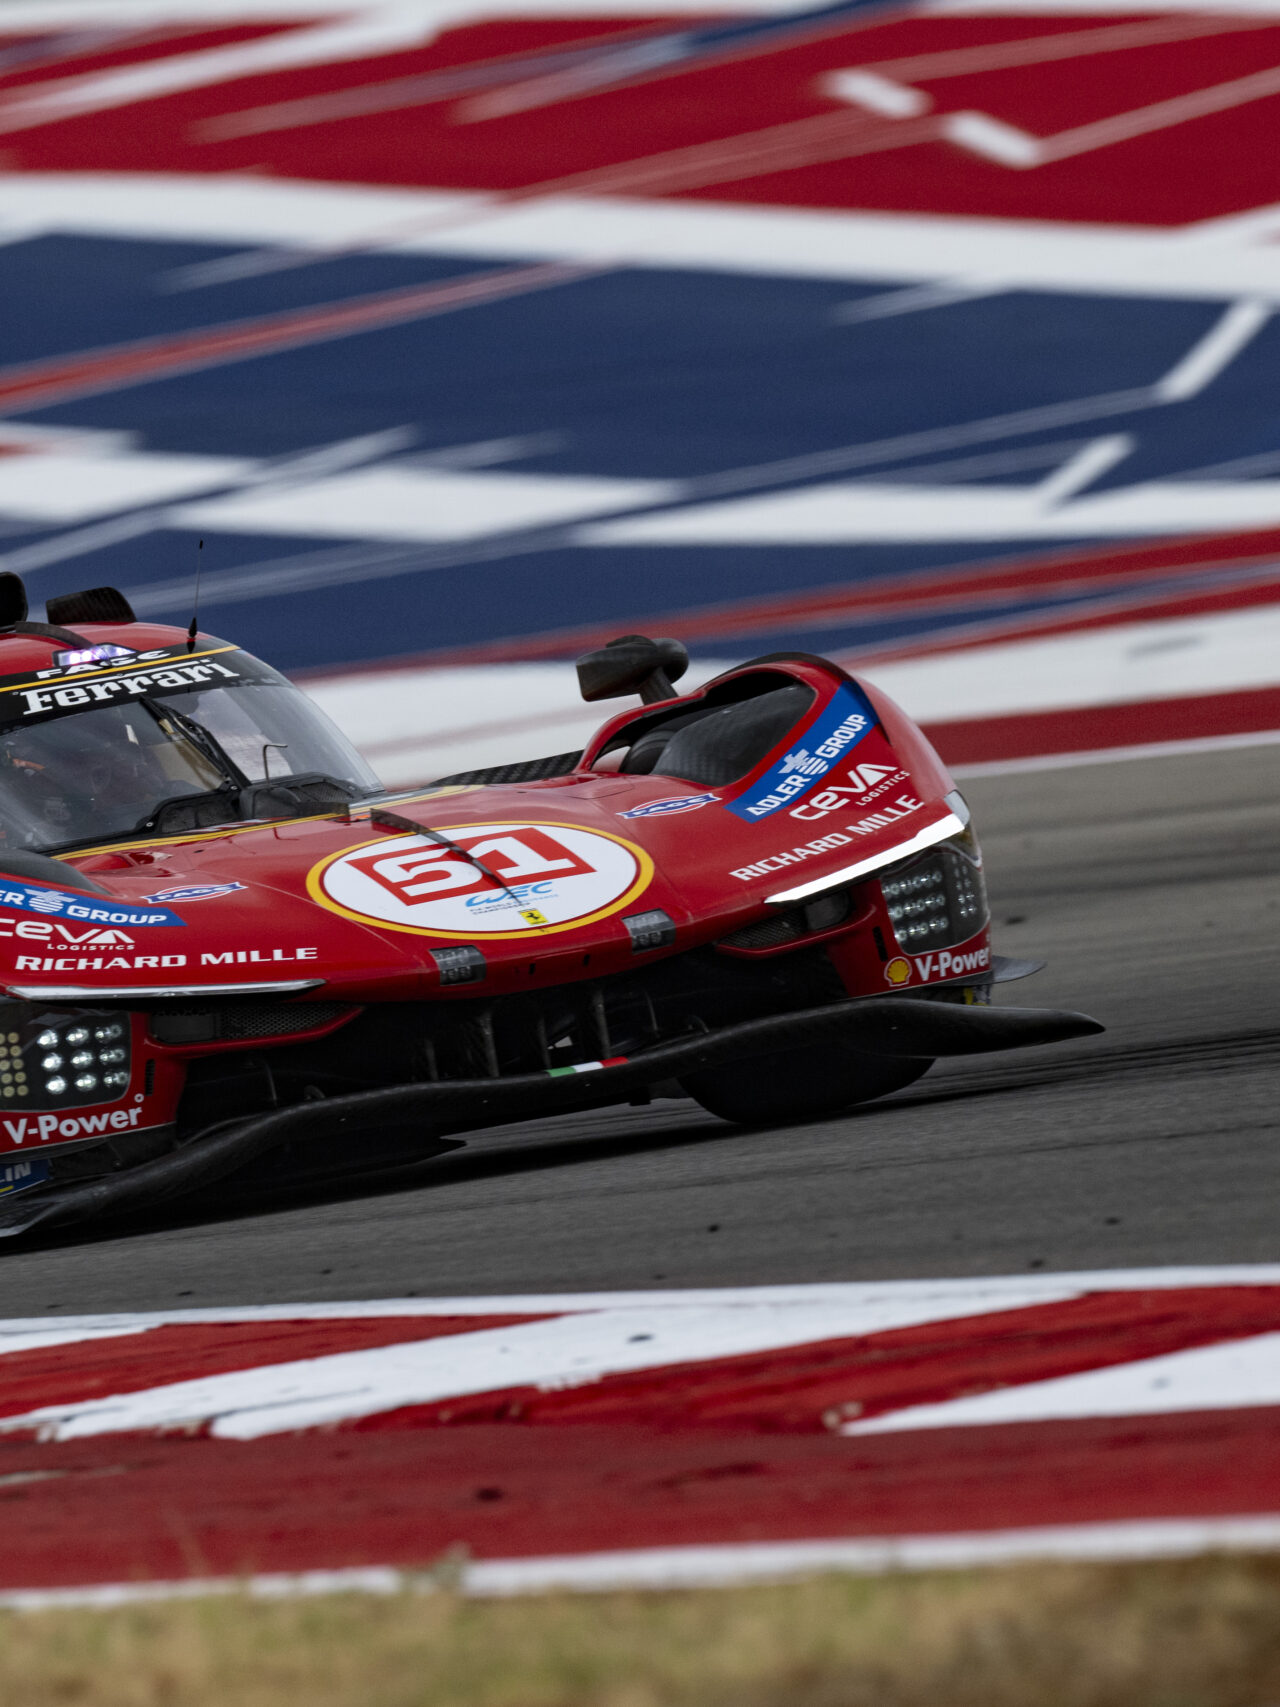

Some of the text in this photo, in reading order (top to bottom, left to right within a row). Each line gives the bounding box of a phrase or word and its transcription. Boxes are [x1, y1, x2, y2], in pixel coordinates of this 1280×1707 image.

[20, 658, 240, 715] Ferrari
[745, 714, 868, 816] ADLER GROUP
[856, 770, 911, 806] LOGISTICS
[730, 794, 925, 881] RICHARD MILLE
[372, 836, 577, 897] 51
[466, 881, 553, 907] WEC
[66, 904, 167, 924] GROUP
[15, 947, 318, 971] RICHARD MILLE
[47, 943, 136, 951] LOGISTICS
[915, 948, 989, 981] V-Power
[3, 1106, 142, 1144] V-Power
